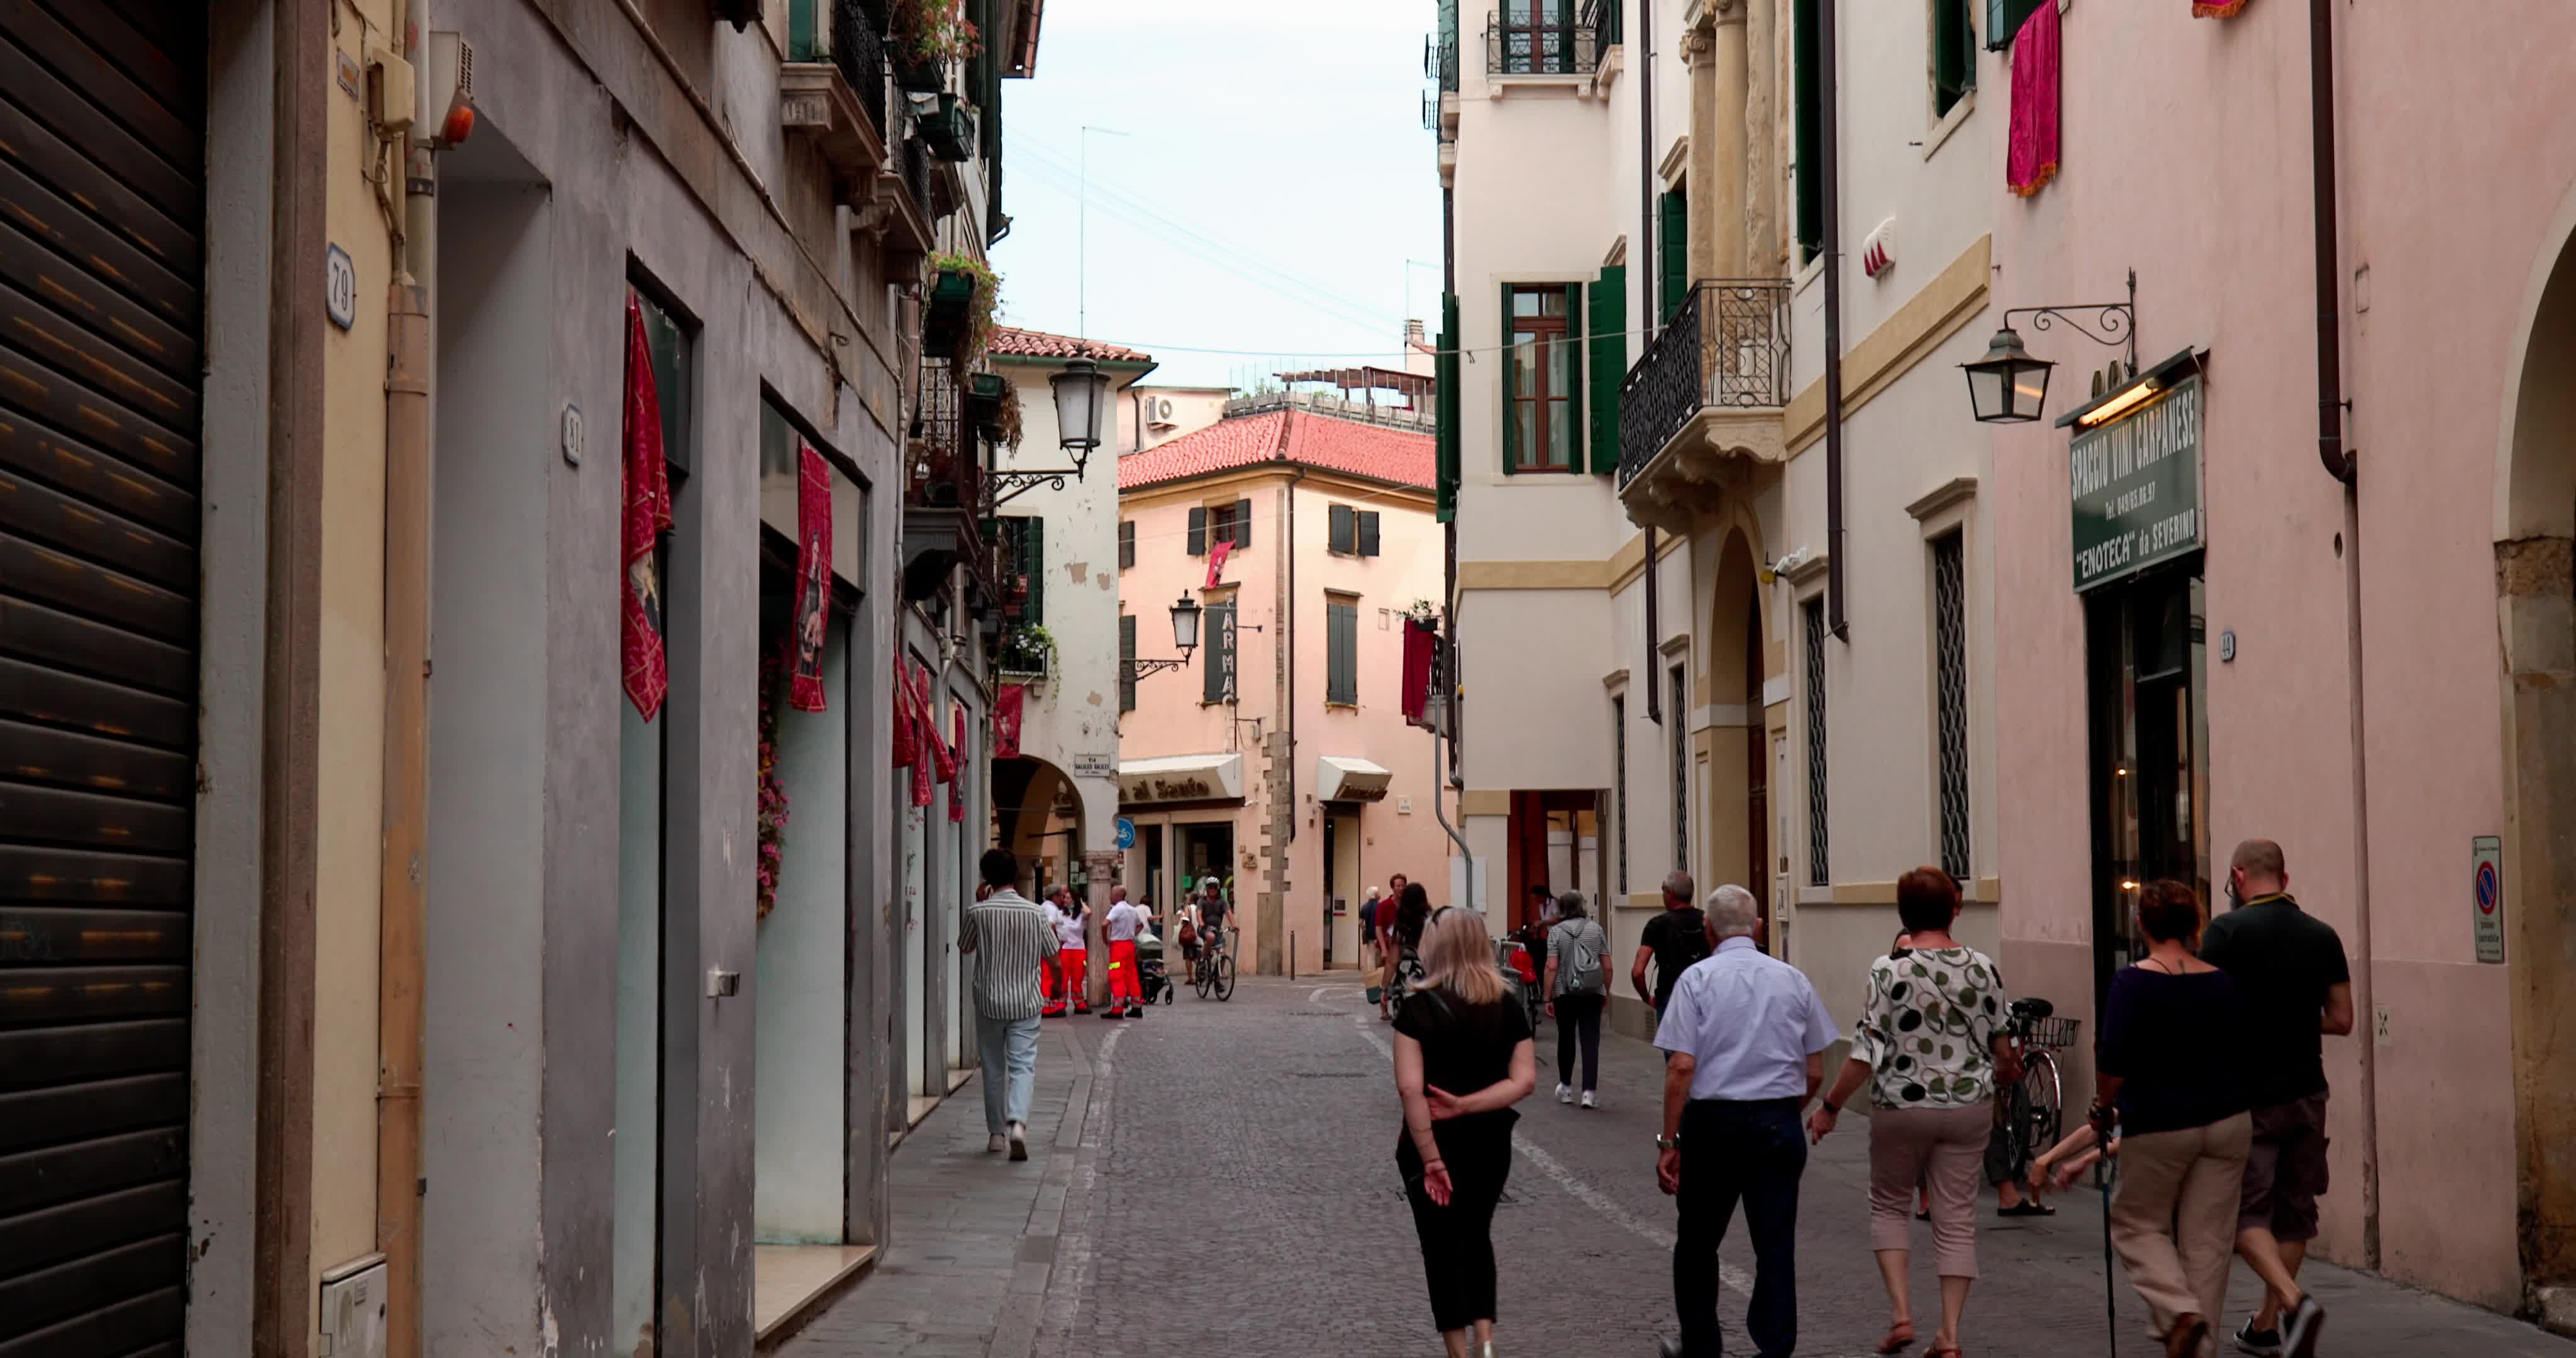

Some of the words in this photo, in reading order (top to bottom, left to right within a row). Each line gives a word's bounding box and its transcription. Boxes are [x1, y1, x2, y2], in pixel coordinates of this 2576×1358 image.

[333, 261, 348, 312] 79
[569, 416, 579, 452] 81
[2071, 434, 2108, 501] SPACCIO
[2111, 422, 2132, 482] VINI
[2136, 389, 2195, 470] CARPANESE
[2105, 499, 2116, 521] Tel.
[2139, 528, 2149, 556] da
[2153, 507, 2195, 551] SEVERINO
